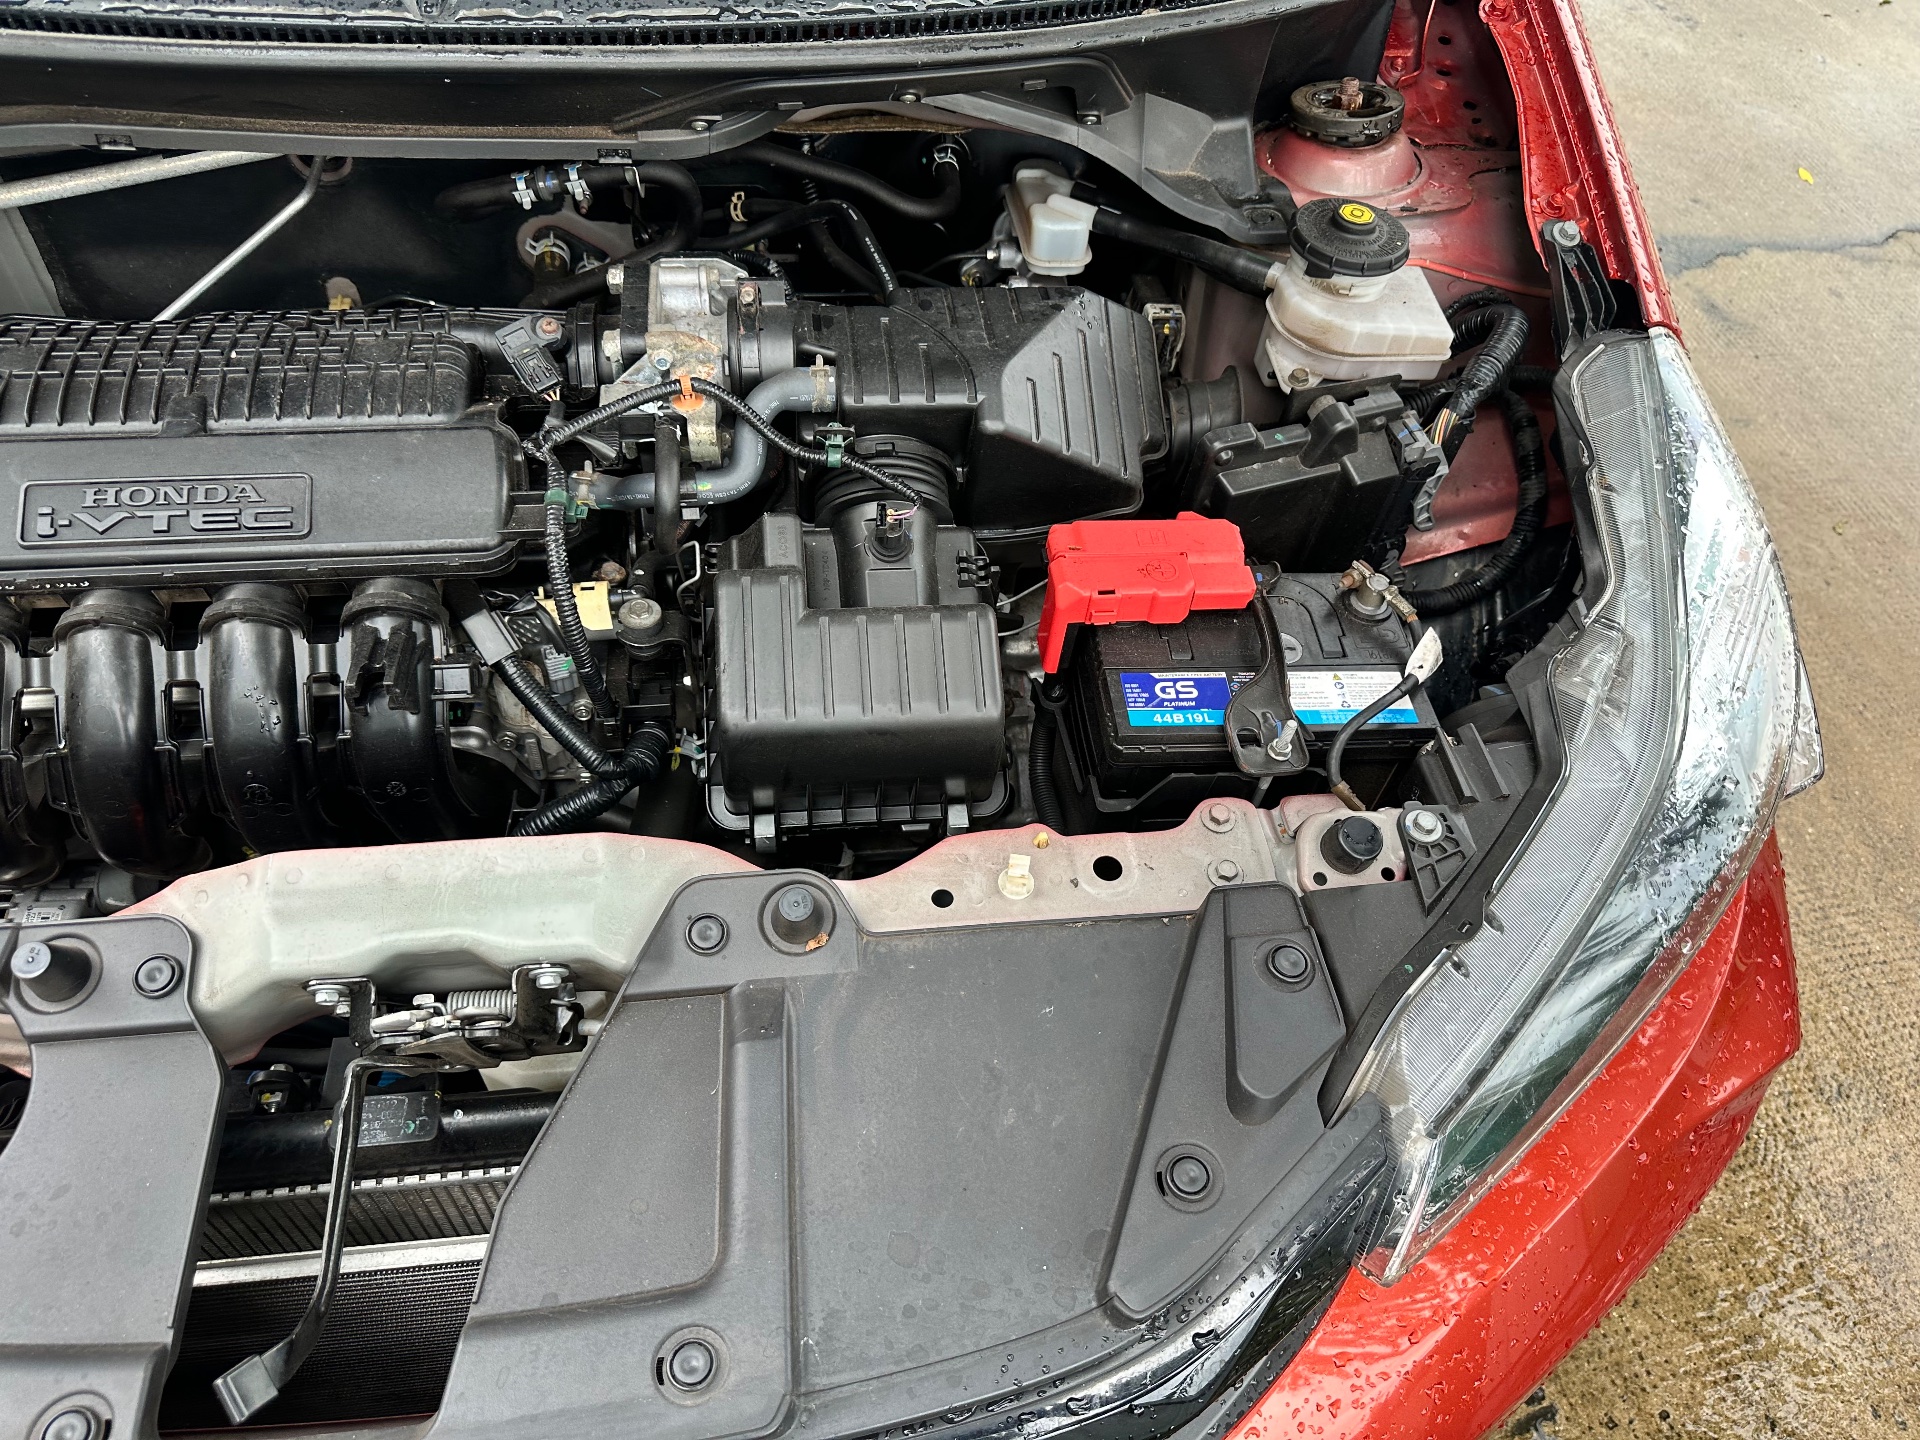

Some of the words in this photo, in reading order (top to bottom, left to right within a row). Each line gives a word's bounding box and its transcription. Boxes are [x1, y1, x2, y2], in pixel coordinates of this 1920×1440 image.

[81, 483, 266, 508] HONDA
[36, 505, 293, 537] i-VTEC
[1154, 681, 1199, 699] GS
[1153, 713, 1216, 723] 44B19L
